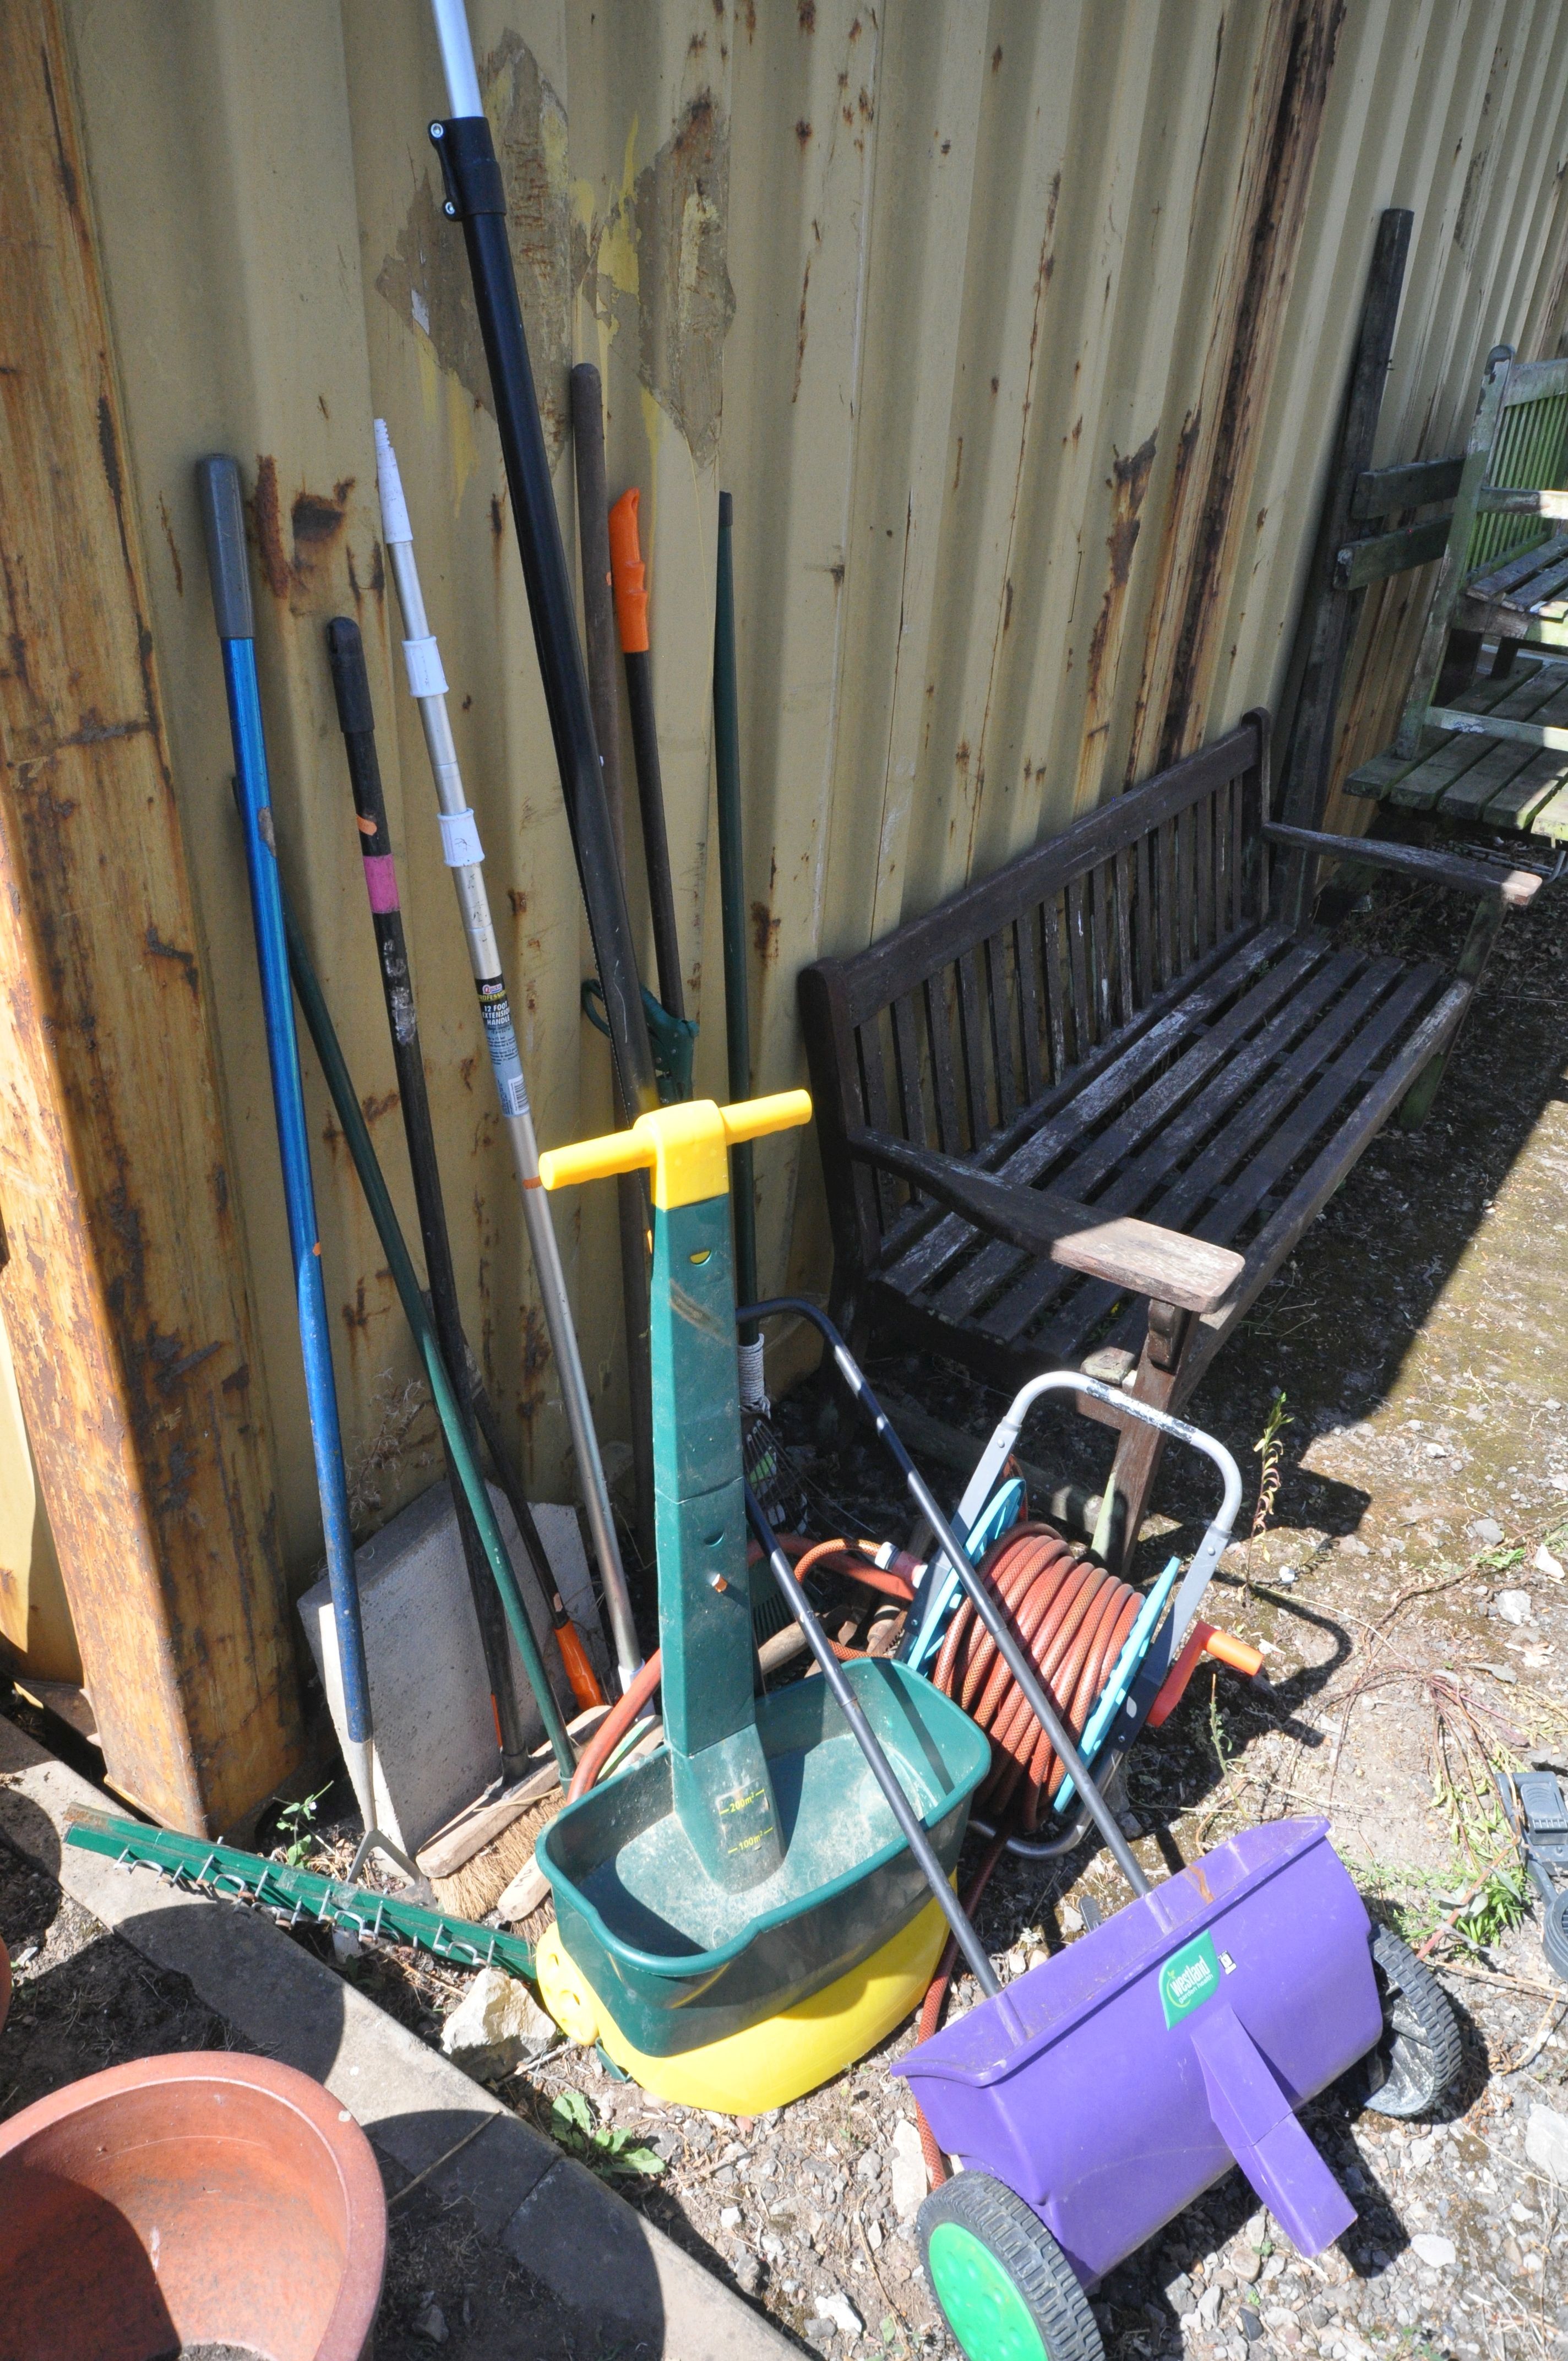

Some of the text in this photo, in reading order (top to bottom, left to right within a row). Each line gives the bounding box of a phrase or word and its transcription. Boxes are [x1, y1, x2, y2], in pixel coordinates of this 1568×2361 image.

[493, 1000, 508, 1011] FOOT
[487, 1015, 510, 1025] HANDLE
[1179, 1974, 1213, 2005] garden health
